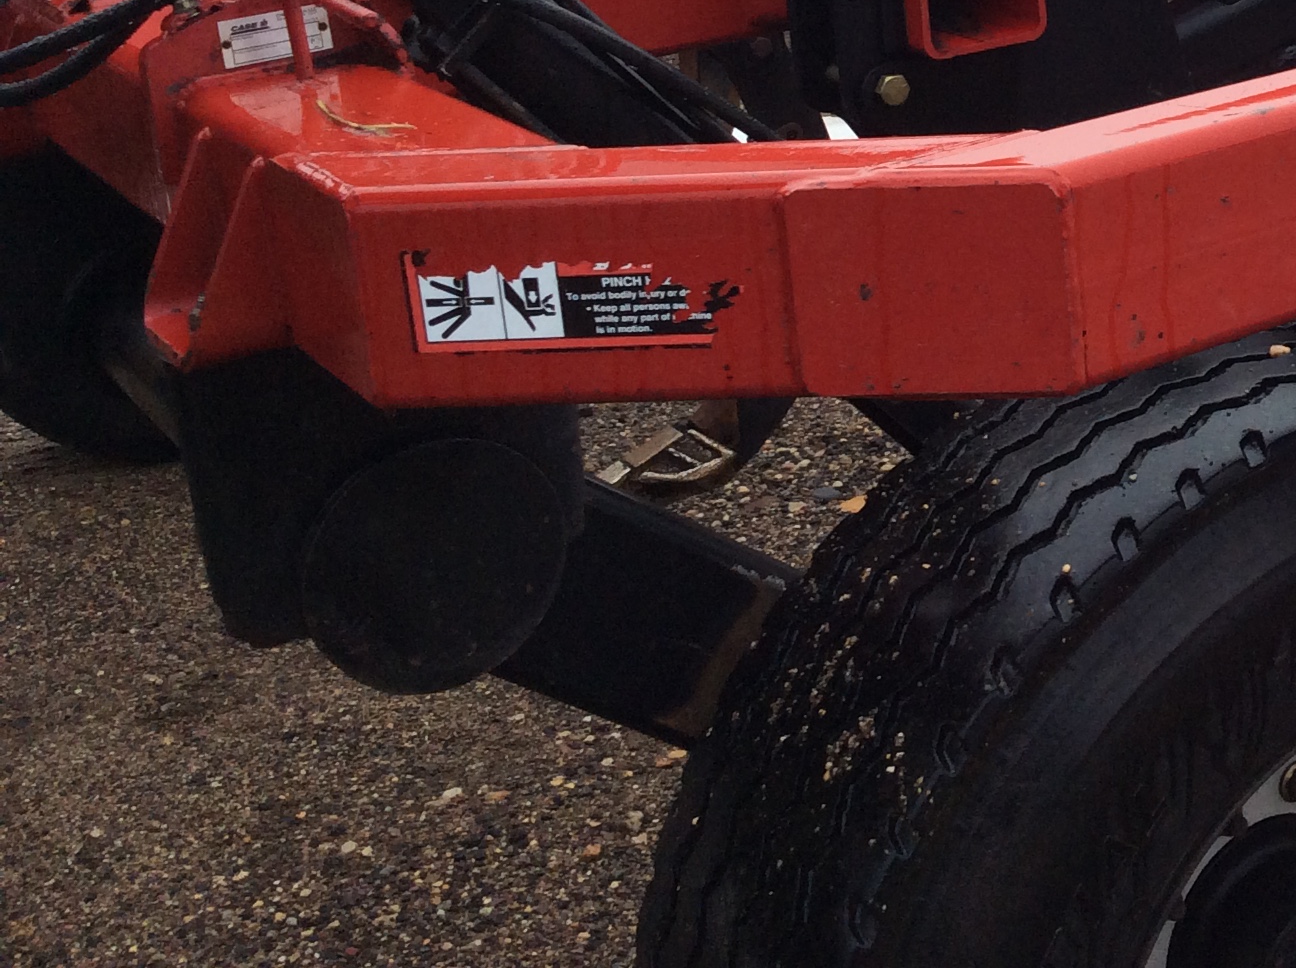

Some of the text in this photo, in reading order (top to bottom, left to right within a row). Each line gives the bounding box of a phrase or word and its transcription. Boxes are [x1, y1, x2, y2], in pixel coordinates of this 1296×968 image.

[231, 20, 258, 32] CASE
[601, 277, 642, 287] PINCH
[580, 292, 605, 300] avoid
[608, 291, 637, 300] bodily
[593, 305, 618, 313] Keep
[632, 303, 671, 311] persons
[640, 314, 659, 322] part
[617, 325, 653, 333] motion.
